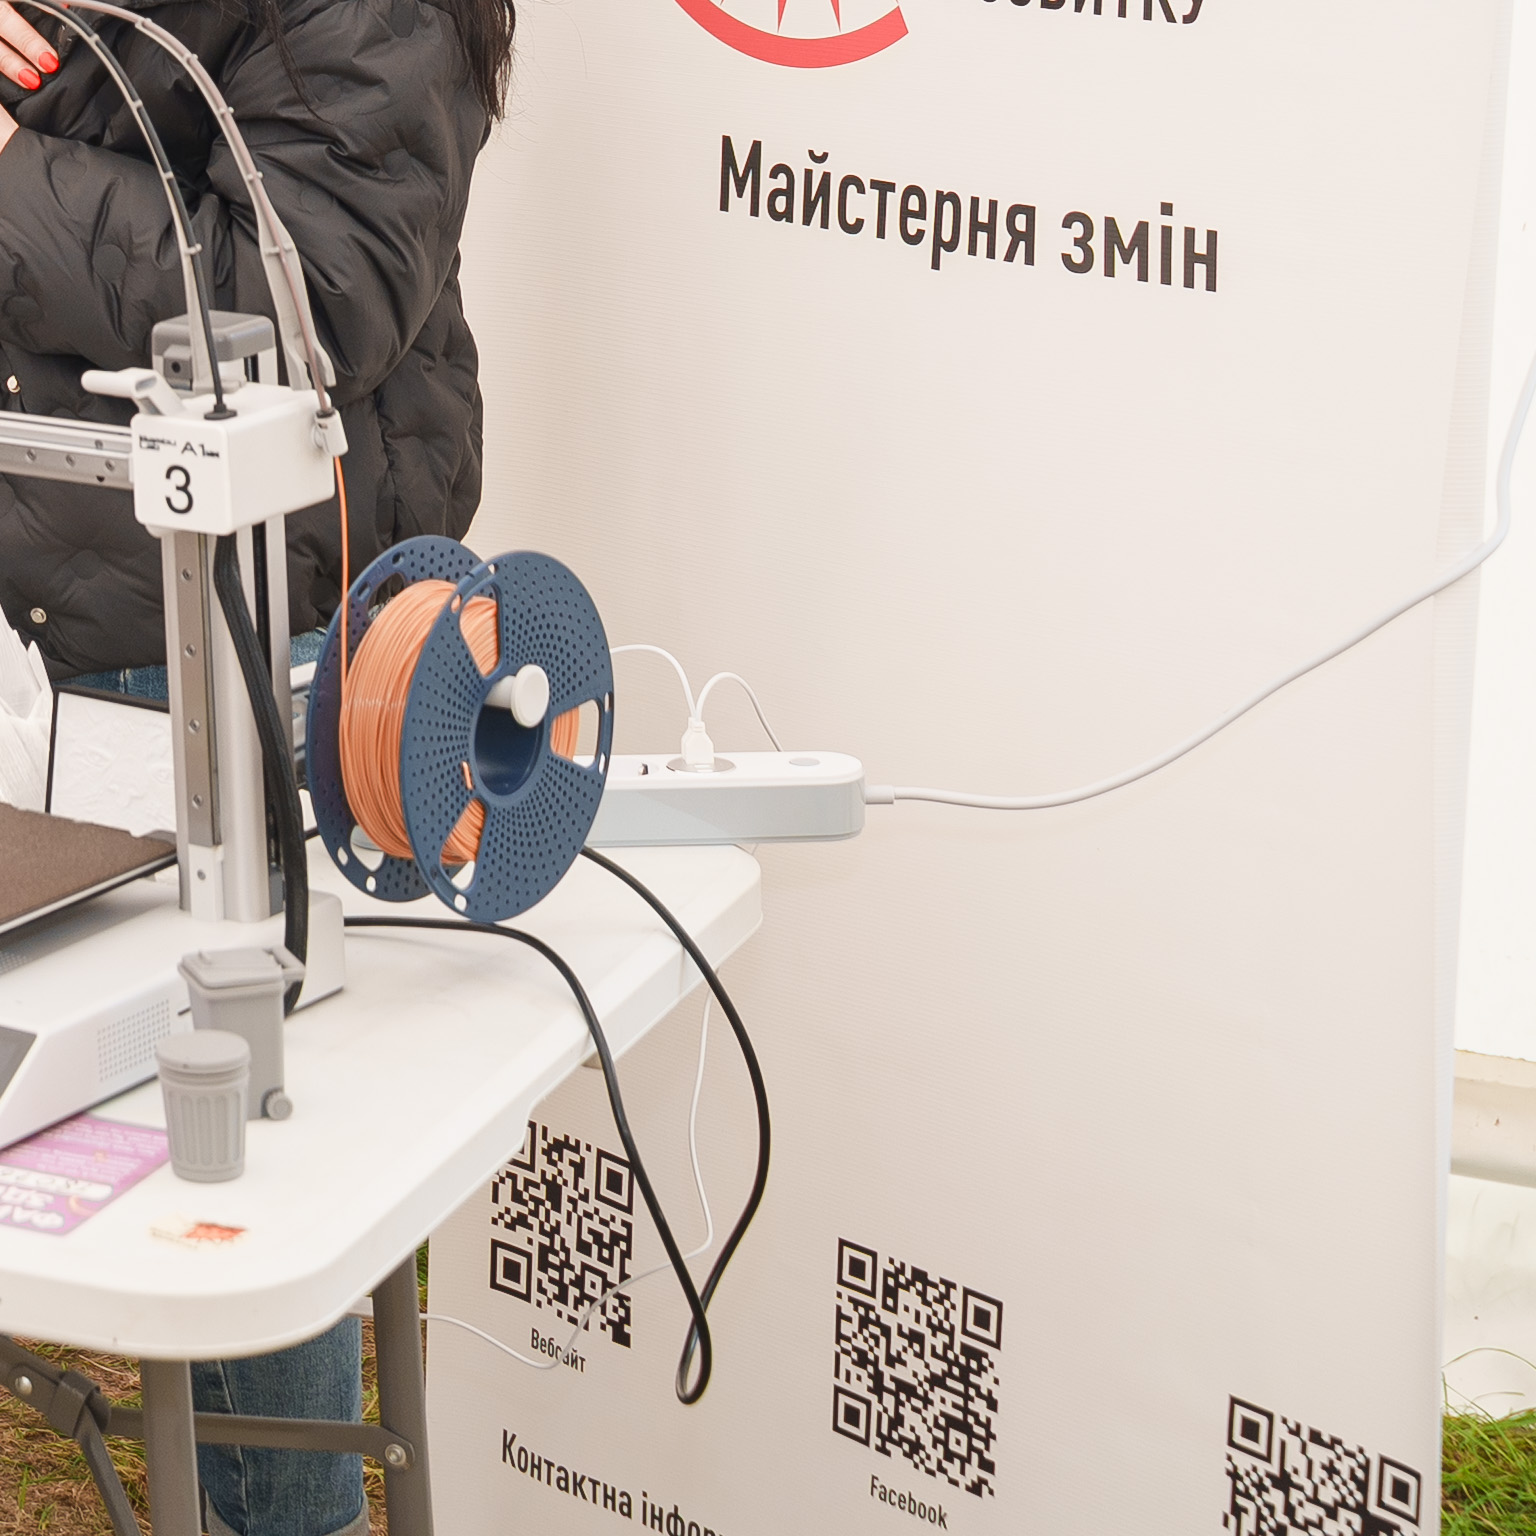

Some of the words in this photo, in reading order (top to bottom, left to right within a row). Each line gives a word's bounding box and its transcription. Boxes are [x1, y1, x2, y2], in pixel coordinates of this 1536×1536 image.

[719, 133, 1037, 272] Майстерня
[1060, 201, 1220, 293] змін
[165, 464, 194, 514] 3
[501, 1428, 633, 1520] Контактна
[641, 1490, 724, 1536] інфо
[870, 1474, 948, 1530] Facebook
